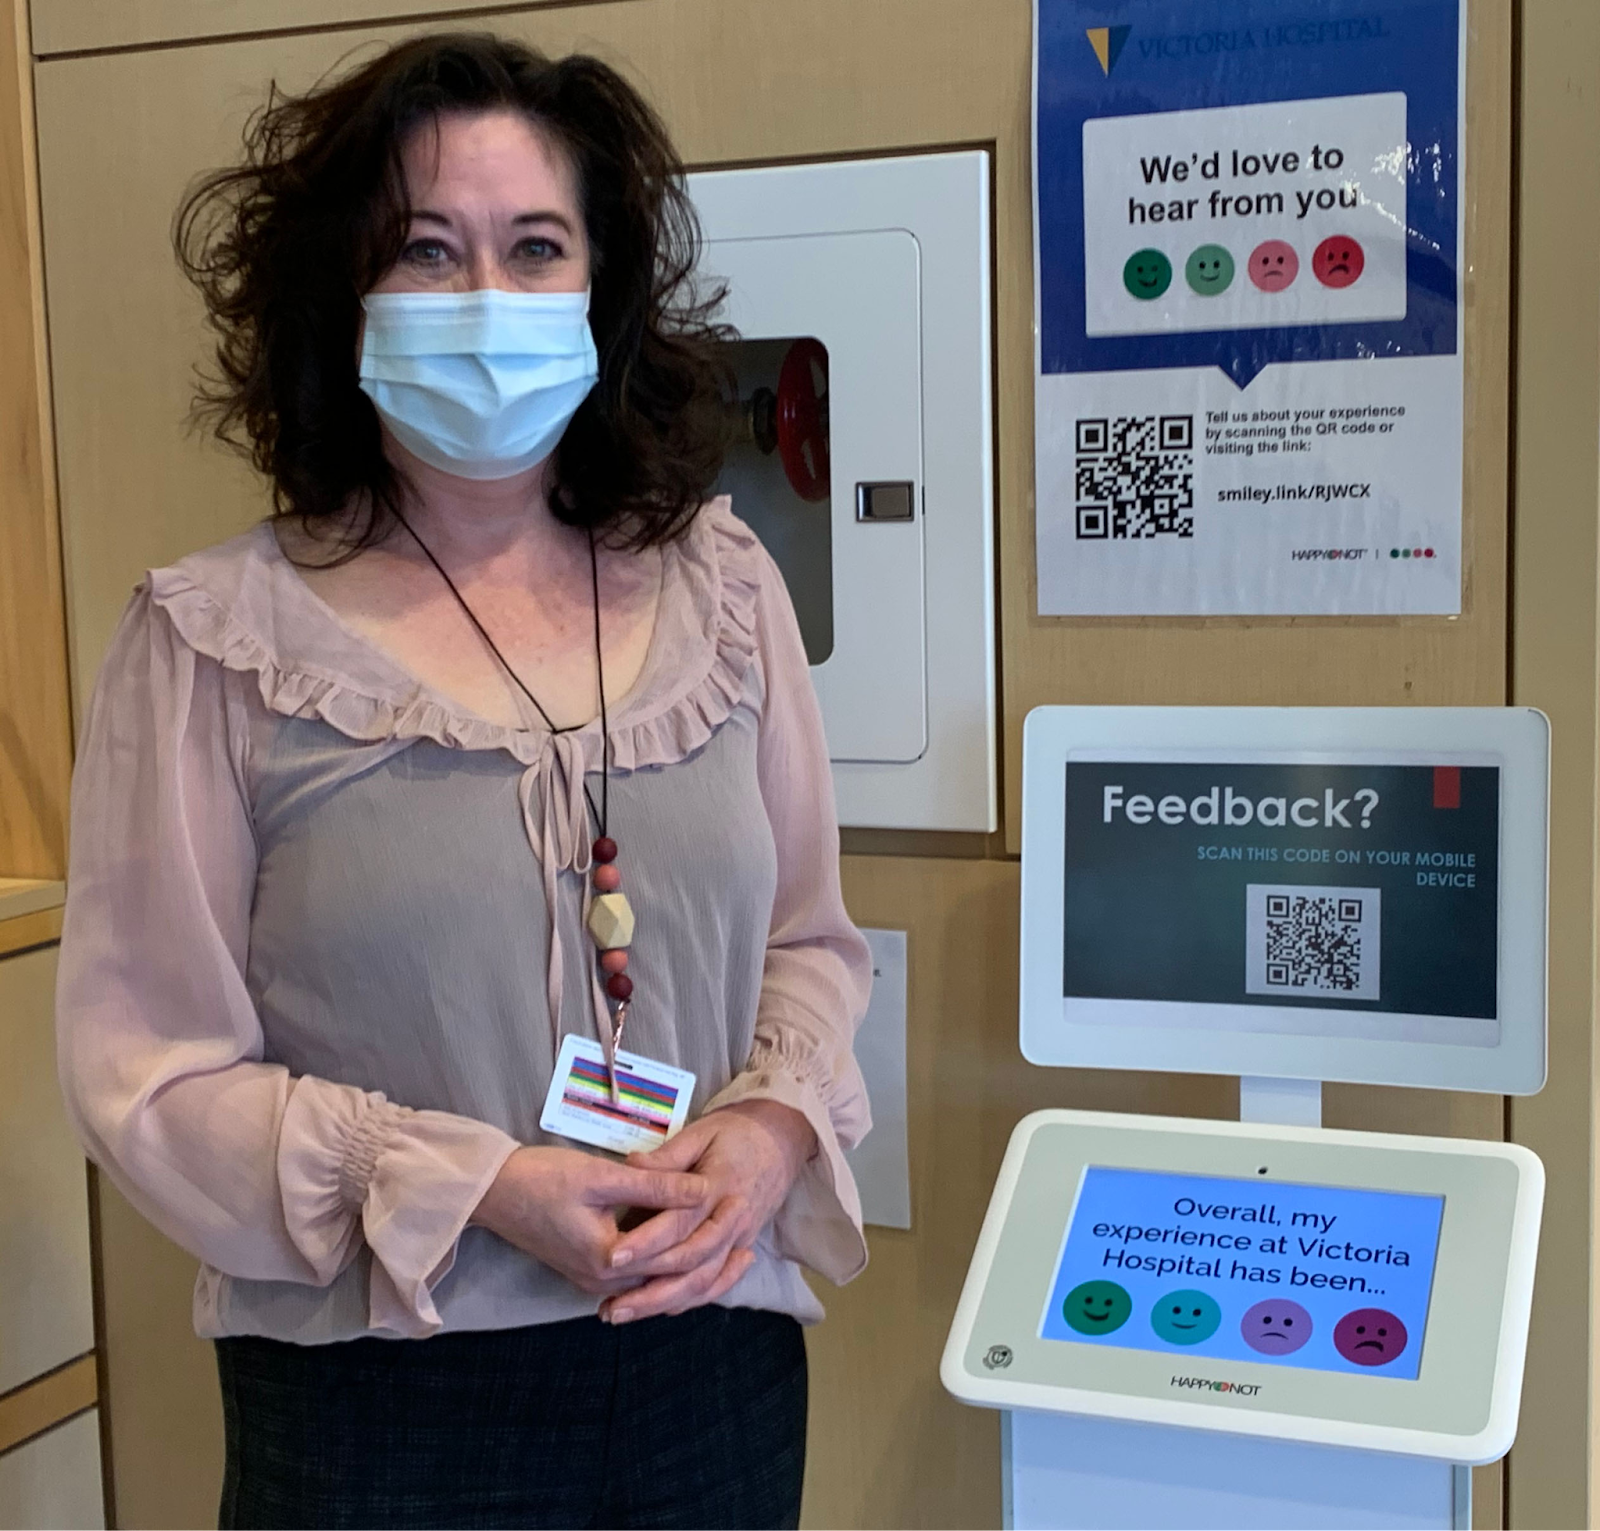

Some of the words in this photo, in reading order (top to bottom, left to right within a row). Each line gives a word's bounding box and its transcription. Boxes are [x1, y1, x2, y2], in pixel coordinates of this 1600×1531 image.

[1138, 28, 1255, 59] VICTORIA
[1264, 16, 1390, 49] HOSPITAL
[1140, 152, 1220, 184] We'd
[1232, 149, 1300, 177] love
[1311, 144, 1344, 171] to
[1128, 196, 1199, 225] hear
[1208, 190, 1283, 219] from
[1296, 187, 1358, 219] you
[1205, 427, 1222, 442] by
[1225, 424, 1287, 440] scanning
[1290, 424, 1312, 437] the
[1315, 422, 1338, 436] QR
[1341, 421, 1376, 435] code
[1379, 422, 1395, 434] or
[1206, 410, 1228, 424] Tell
[1232, 412, 1249, 424] us
[1252, 408, 1290, 422] about
[1294, 408, 1326, 423] your
[1329, 404, 1406, 421] experience
[1205, 442, 1254, 458] visiting
[1257, 440, 1279, 454] the
[1217, 483, 1372, 505] smiley.link/RJWCX
[1103, 785, 1380, 829] Feedback?
[1197, 846, 1243, 861] SCAN
[1247, 847, 1279, 862] THIS
[1283, 848, 1331, 864] CODE
[1335, 850, 1361, 865] ON
[1366, 850, 1412, 866] YOUR
[1415, 852, 1476, 868] MOBILE
[1416, 872, 1476, 888] DEVICE
[1174, 1197, 1282, 1227] Overall,
[1291, 1209, 1338, 1235] my
[1092, 1221, 1252, 1252] experience
[1259, 1234, 1288, 1256] at
[1298, 1236, 1411, 1268] Victoria
[1102, 1247, 1222, 1279] Hospital
[1230, 1259, 1282, 1285] has
[1290, 1266, 1387, 1296] been...
